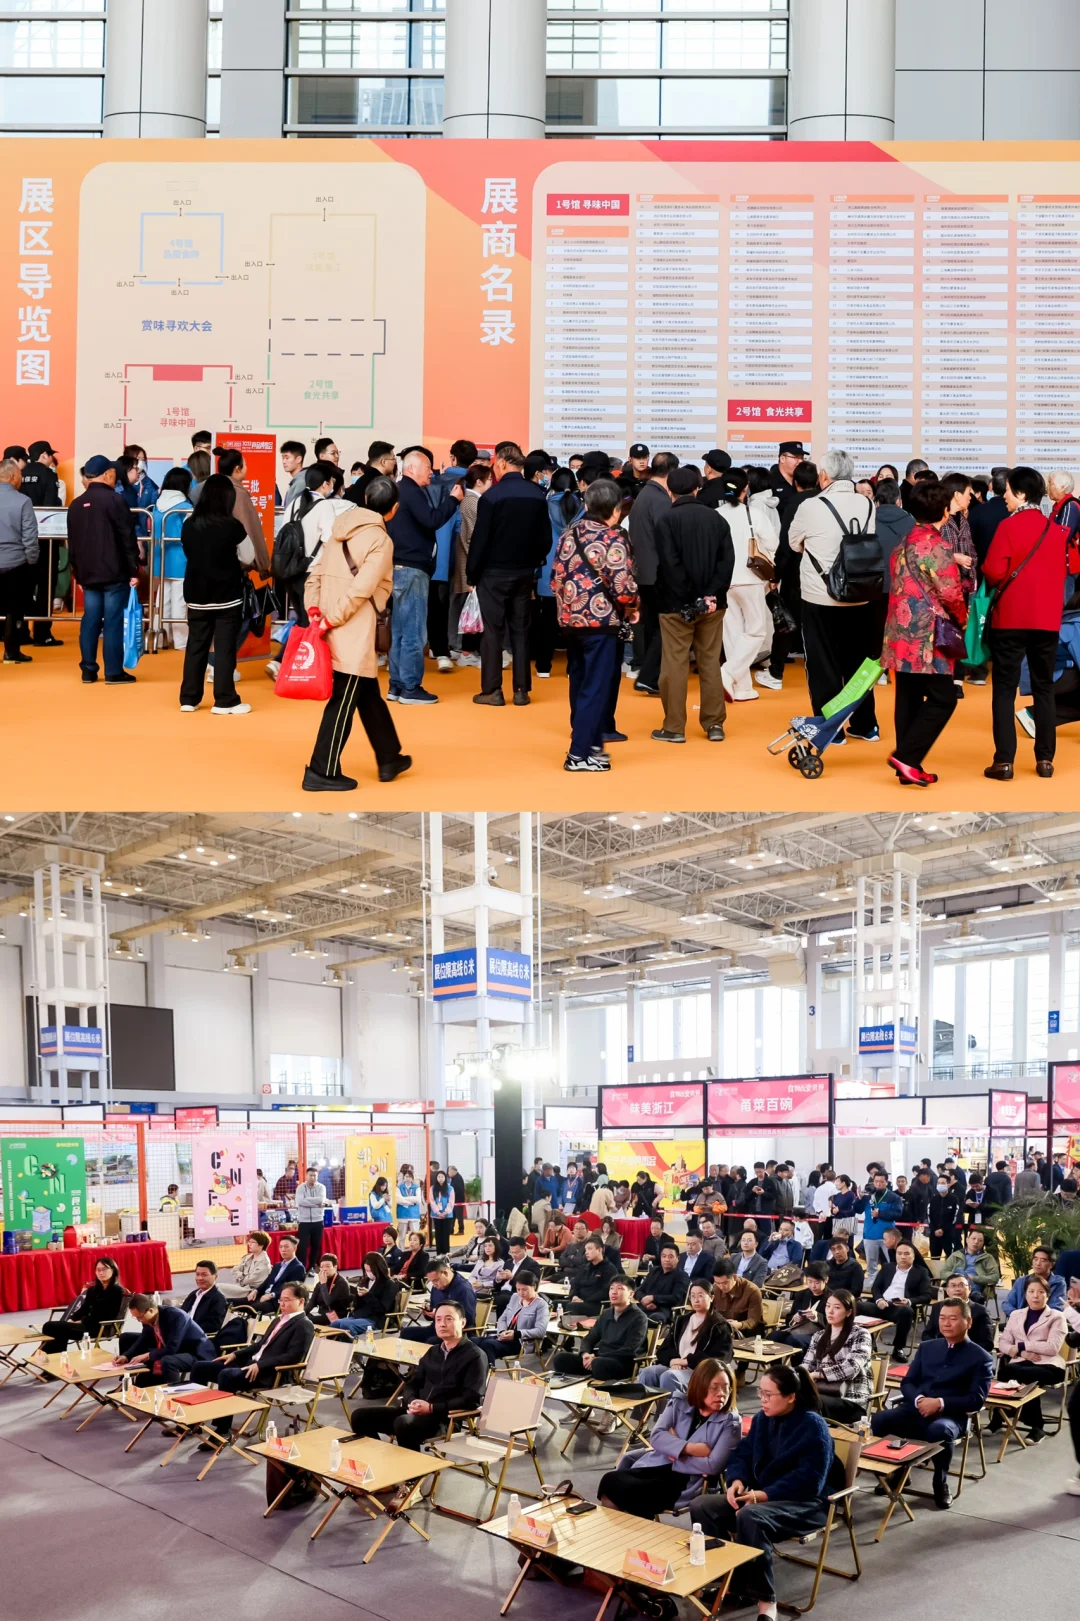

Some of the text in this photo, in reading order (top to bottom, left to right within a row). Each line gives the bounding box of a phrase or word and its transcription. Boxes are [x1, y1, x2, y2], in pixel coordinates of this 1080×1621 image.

[556, 199, 620, 210] 1号馆 寻味中国
[480, 177, 518, 346] 展商名录
[16, 177, 54, 386] 展区导览图
[141, 320, 213, 332] 赏味寻欢大会
[104, 371, 123, 379] 出入口
[234, 373, 253, 381] 出入口
[309, 380, 334, 389] 2号馆
[245, 387, 264, 395] 出入口
[303, 390, 339, 400] 食光共享
[166, 407, 190, 417] 1号馆
[735, 406, 804, 418] 2号馆 食光共享
[160, 418, 196, 428] 寻味中国
[21, 475, 38, 483] 保安
[434, 957, 475, 980] 展位限高线6米
[489, 957, 530, 981] 展位限高线6米
[808, 1005, 816, 1016] 3
[629, 1101, 675, 1115] 味美浙江
[740, 1097, 793, 1113] 甬菜百碗
[211, 1151, 221, 1170] C
[230, 1167, 241, 1185] N
